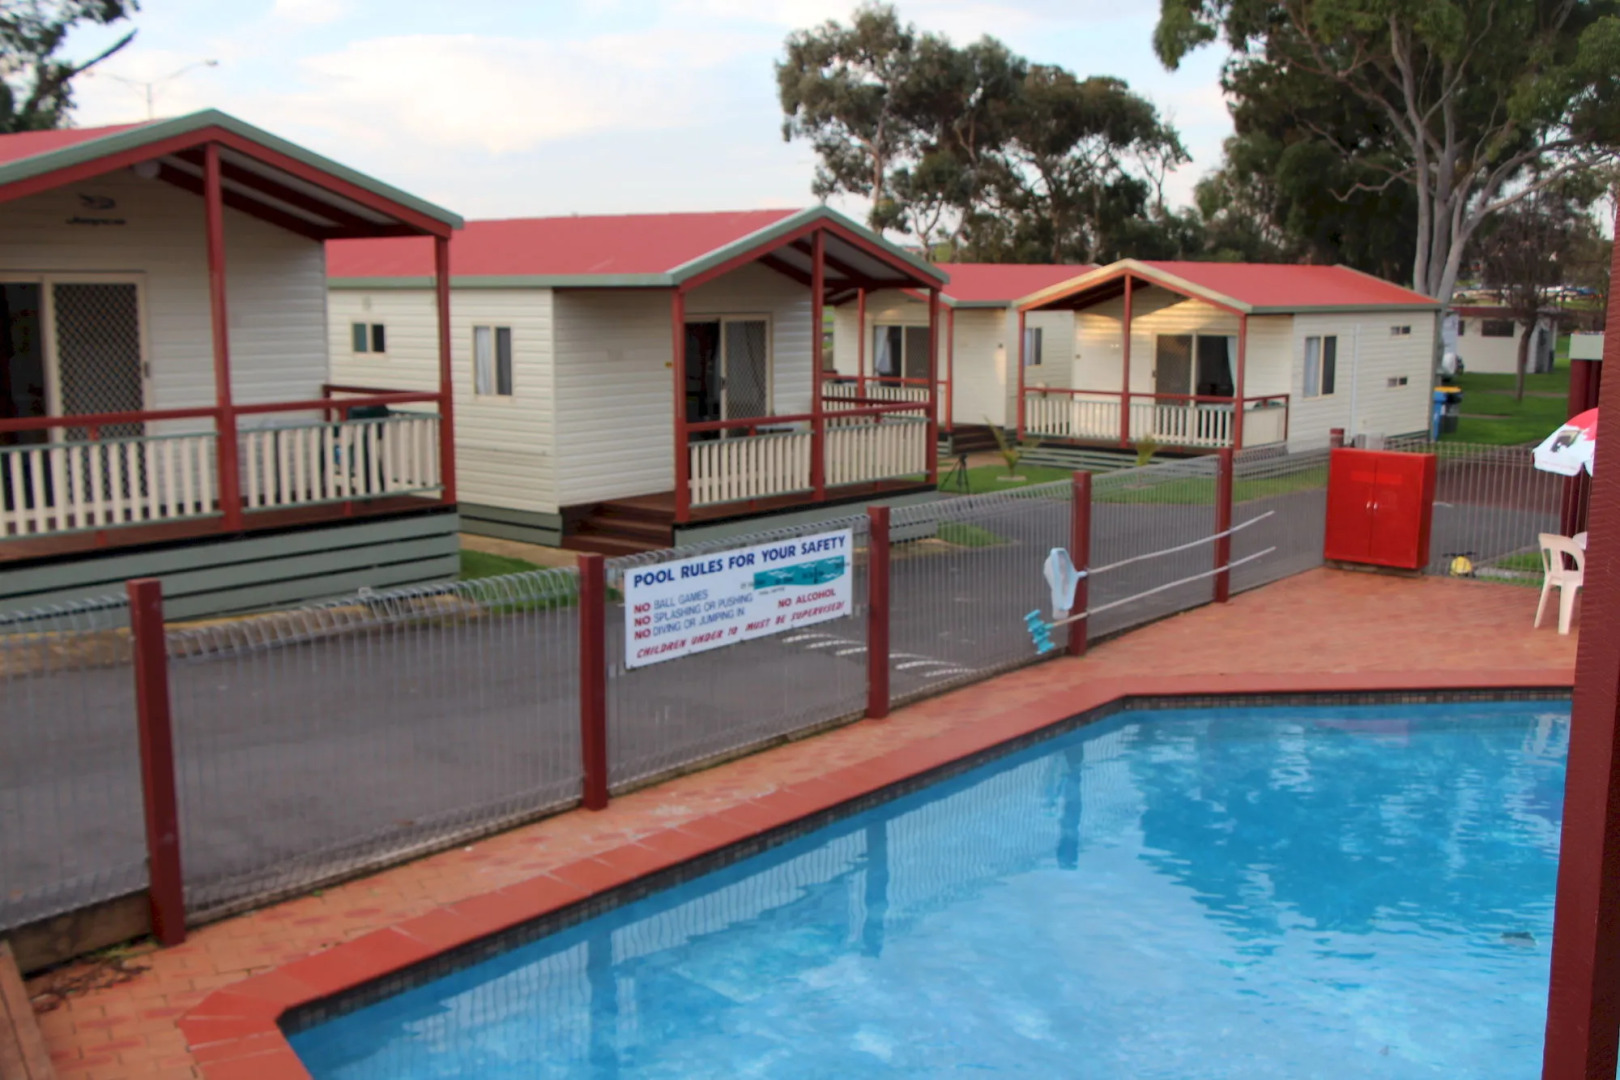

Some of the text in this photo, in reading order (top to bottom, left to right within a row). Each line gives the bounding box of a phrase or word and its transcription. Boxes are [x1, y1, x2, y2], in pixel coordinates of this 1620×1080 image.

[634, 535, 846, 588] POOL RULES FOR YOUR SAFETY
[634, 589, 709, 614] NO BALL GAMES
[634, 593, 753, 627] NO SPLASHING OR PUSHING
[778, 598, 792, 608] NO
[795, 588, 836, 604] ALCOHOL
[634, 607, 745, 640] NO DIVING OR JUMPING IN
[637, 639, 686, 658] CHILDREN
[691, 630, 723, 645] UNDER
[745, 618, 771, 631] MUST
[775, 615, 786, 625] BE
